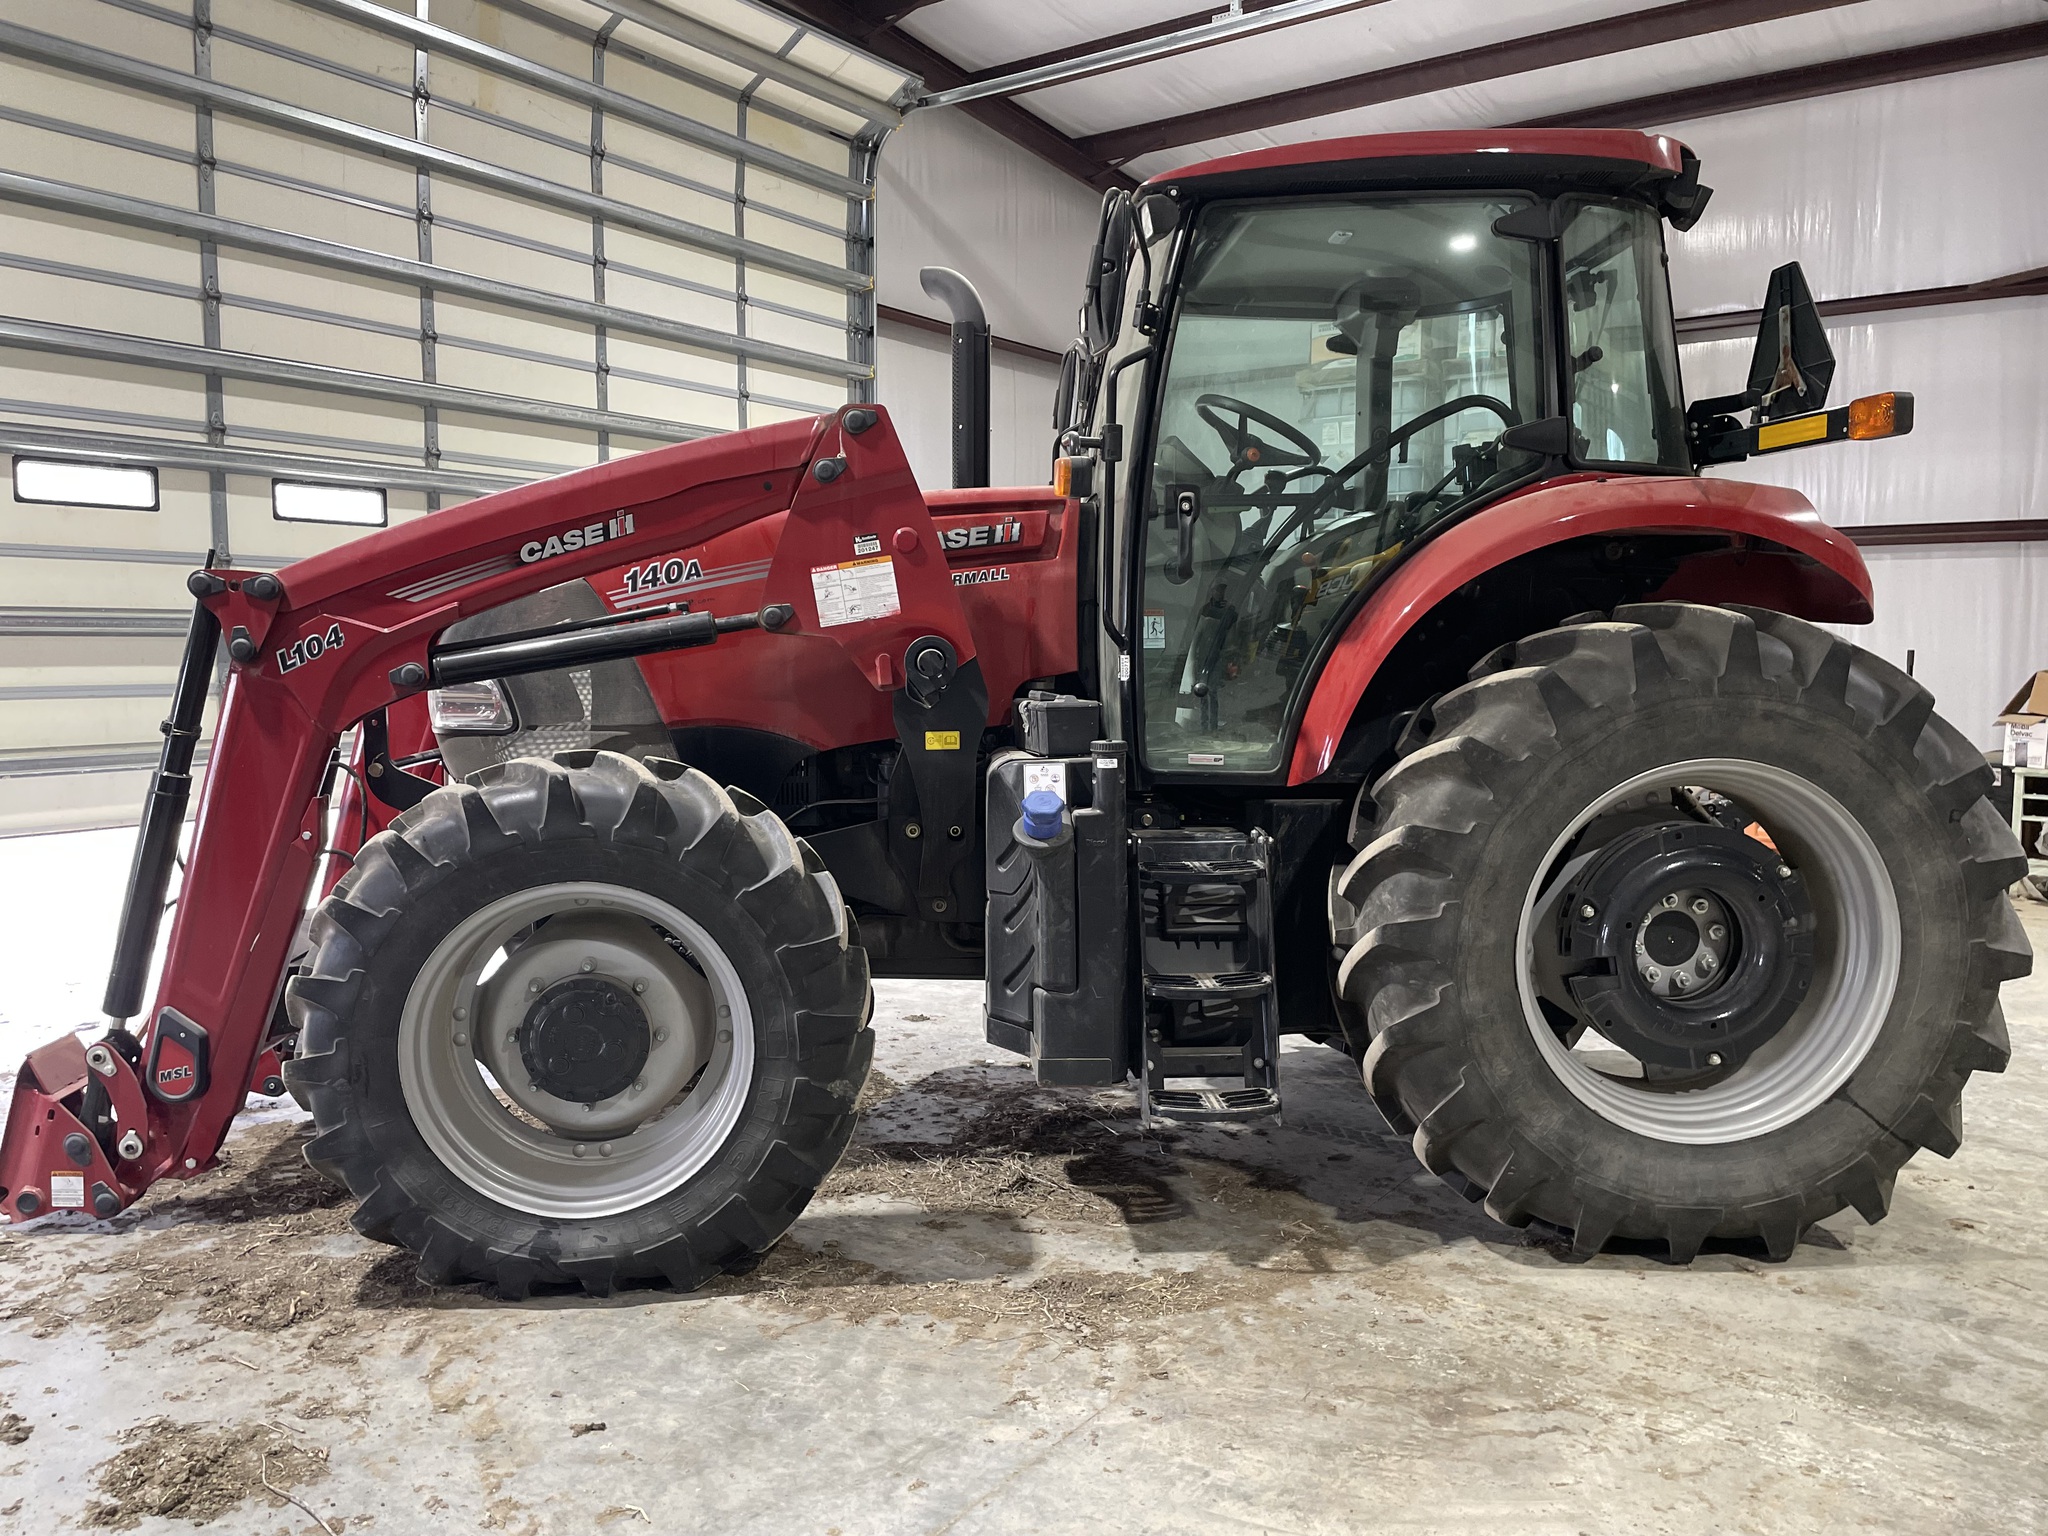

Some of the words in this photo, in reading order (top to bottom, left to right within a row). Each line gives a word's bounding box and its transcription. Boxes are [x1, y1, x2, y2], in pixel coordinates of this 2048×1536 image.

[520, 522, 604, 563] CASE
[937, 526, 990, 549] SE
[624, 557, 703, 594] 140A
[816, 564, 838, 572] DANGER
[951, 567, 1010, 587] RMALL
[276, 622, 345, 675] L104
[2010, 730, 2033, 738] Delvac
[159, 1065, 193, 1083] MSL
[579, 1077, 785, 1248] MICHELIN
